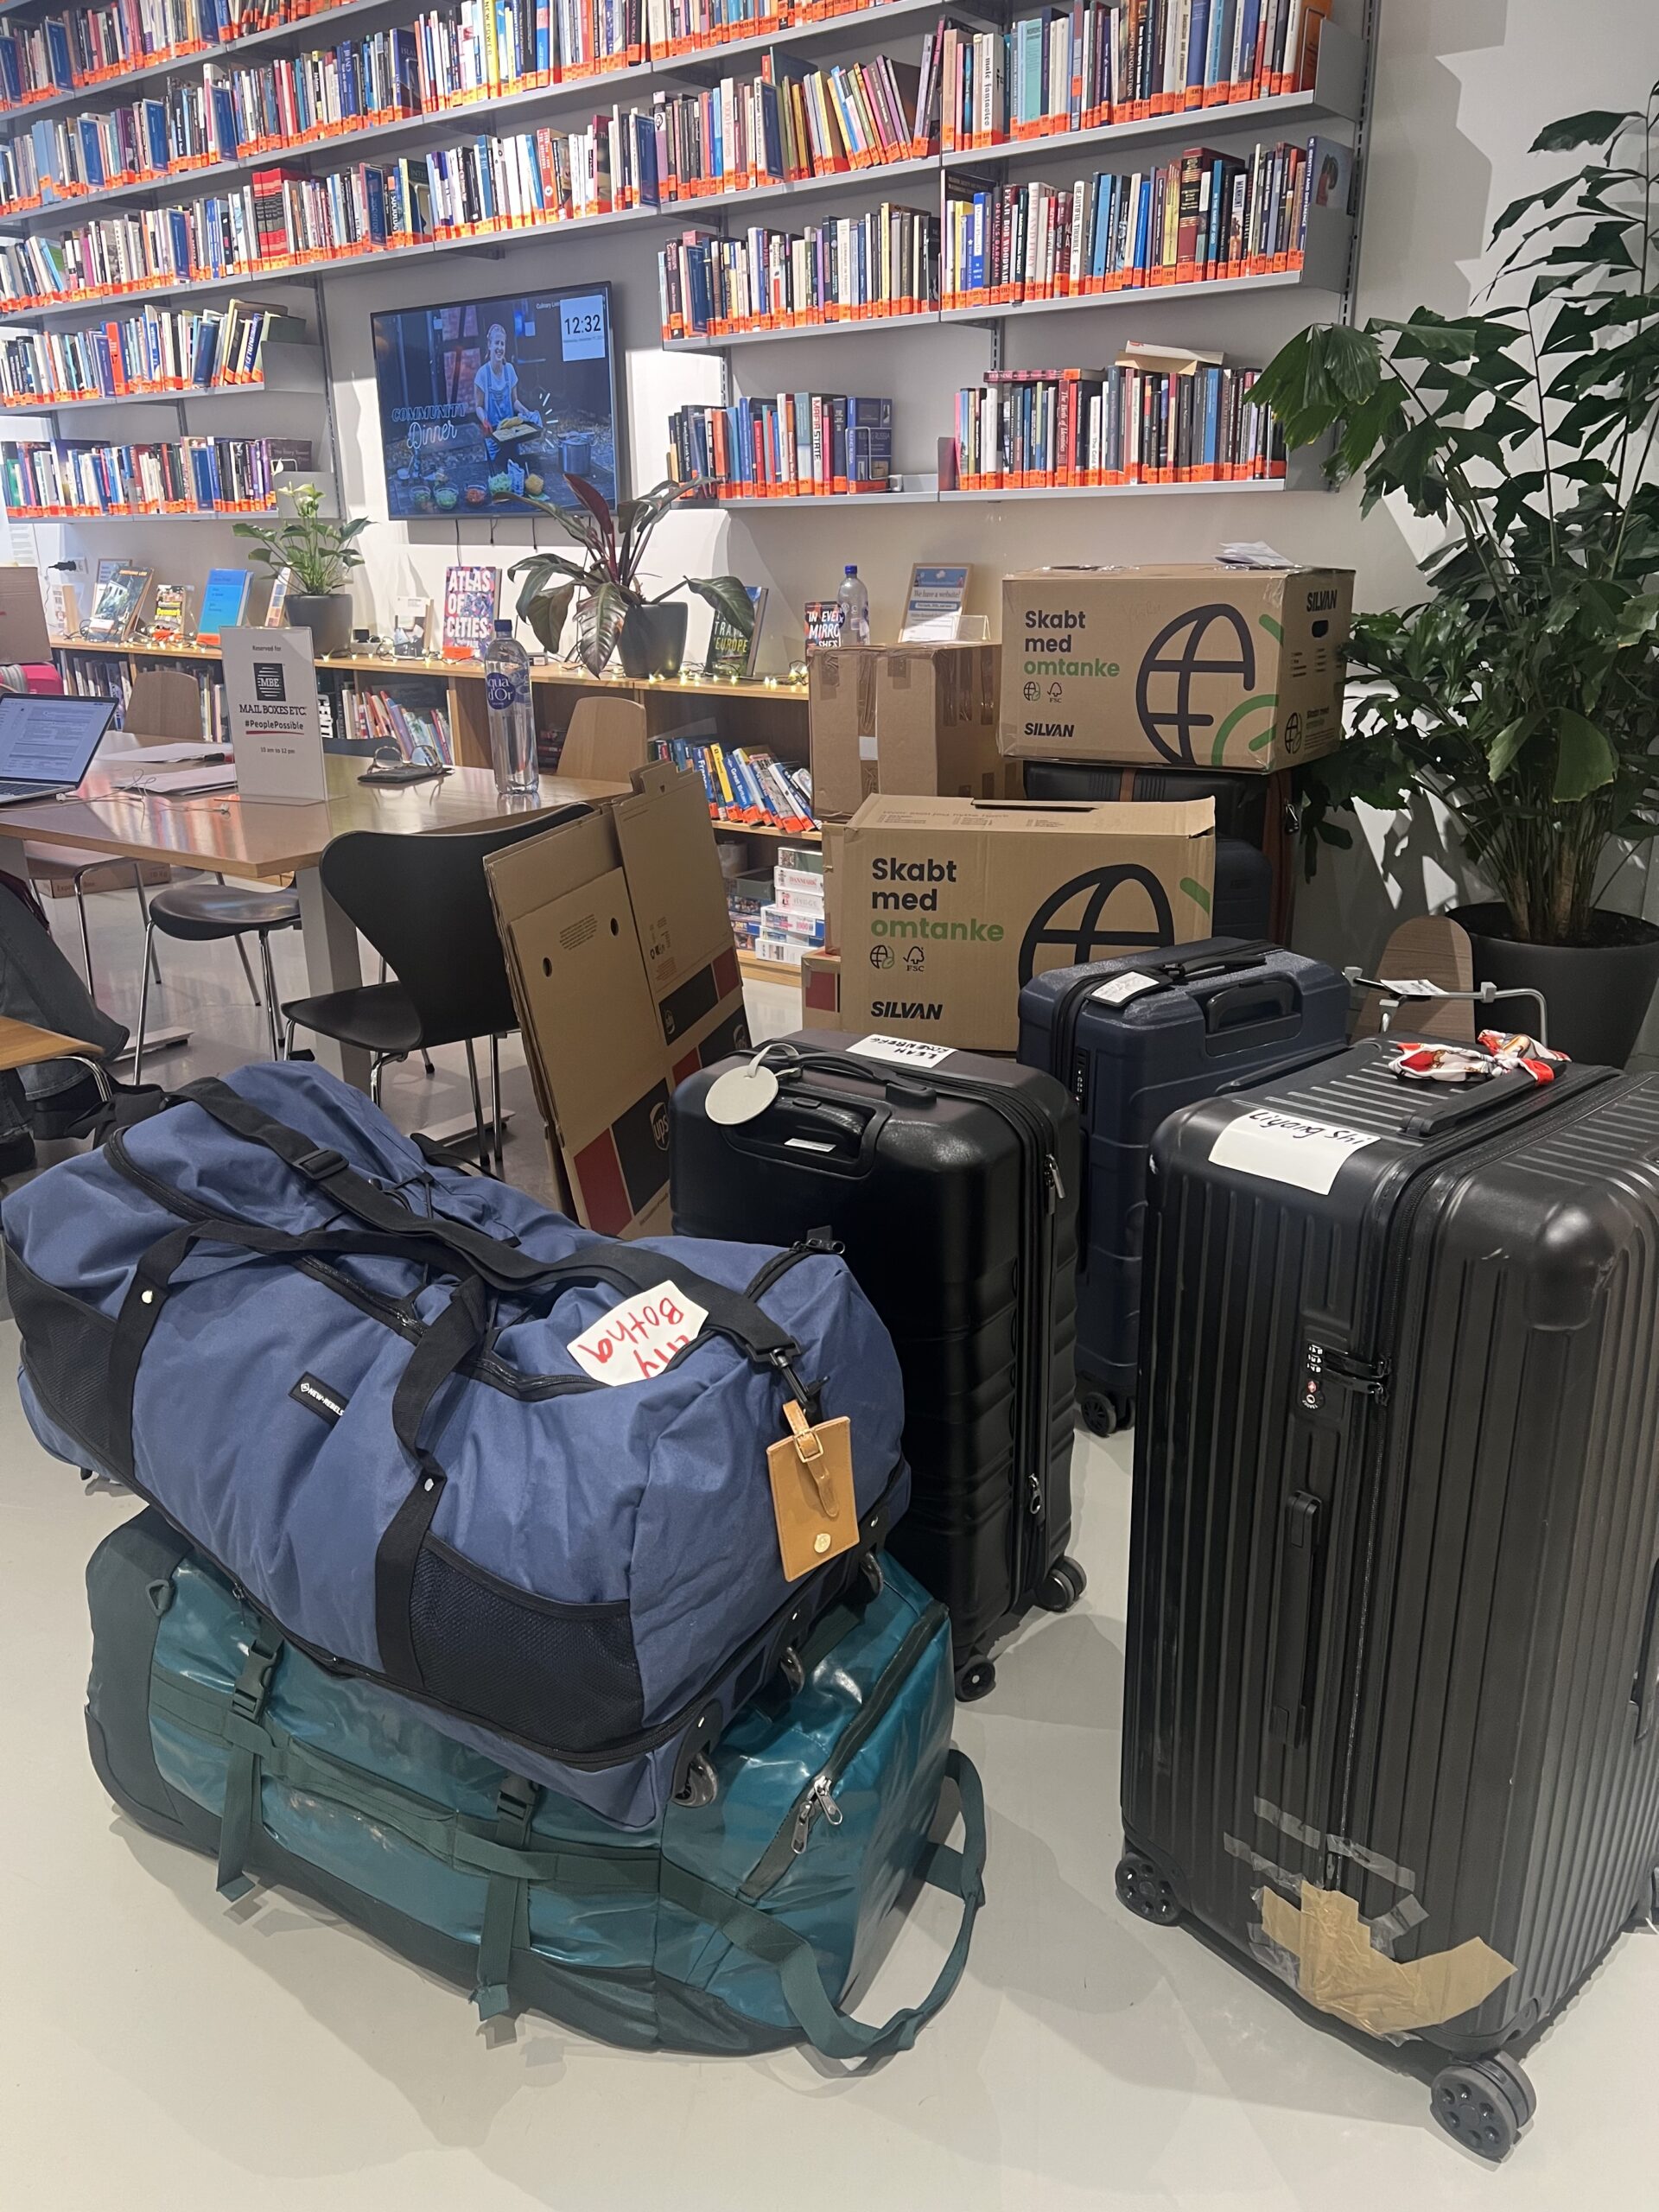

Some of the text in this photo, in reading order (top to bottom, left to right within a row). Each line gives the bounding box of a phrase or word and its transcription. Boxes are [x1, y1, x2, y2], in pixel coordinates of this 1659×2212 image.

[1233, 181, 1243, 207] MANHUNT
[1028, 216, 1037, 238] AND
[1071, 186, 1082, 254] BEAUTIFUL TROUBLE
[564, 314, 601, 335] 12:32
[391, 403, 467, 423] COMMUNITY
[406, 420, 457, 449] Dinner
[448, 570, 491, 592] ATLAS
[448, 593, 465, 616] OF
[1306, 589, 1338, 613] SILVAN
[447, 616, 490, 638] CITIES
[807, 611, 818, 623] IN
[1024, 609, 1086, 630] Skabt
[714, 620, 745, 638] TRAVE
[810, 623, 840, 639] MIRRO
[715, 638, 747, 652] EUROPE
[1025, 635, 1071, 653] med
[1023, 658, 1120, 678] omtanke
[262, 677, 280, 688] MBE
[488, 688, 513, 702] d'Or
[239, 704, 262, 714] MAIL
[263, 705, 289, 715] BOXES
[245, 719, 304, 730] #PeoplePossible
[1024, 722, 1074, 738] SILVAN
[728, 767, 749, 804] Great Britain
[871, 857, 957, 882] Skabt
[789, 876, 817, 887] DANMARK
[871, 888, 938, 912] med
[870, 918, 1004, 943] omtanke
[870, 1001, 943, 1020] SILVAN
[1324, 1129, 1372, 1145] Shi
[576, 1297, 684, 1364] Botha
[322, 1397, 345, 1416] REBELS
